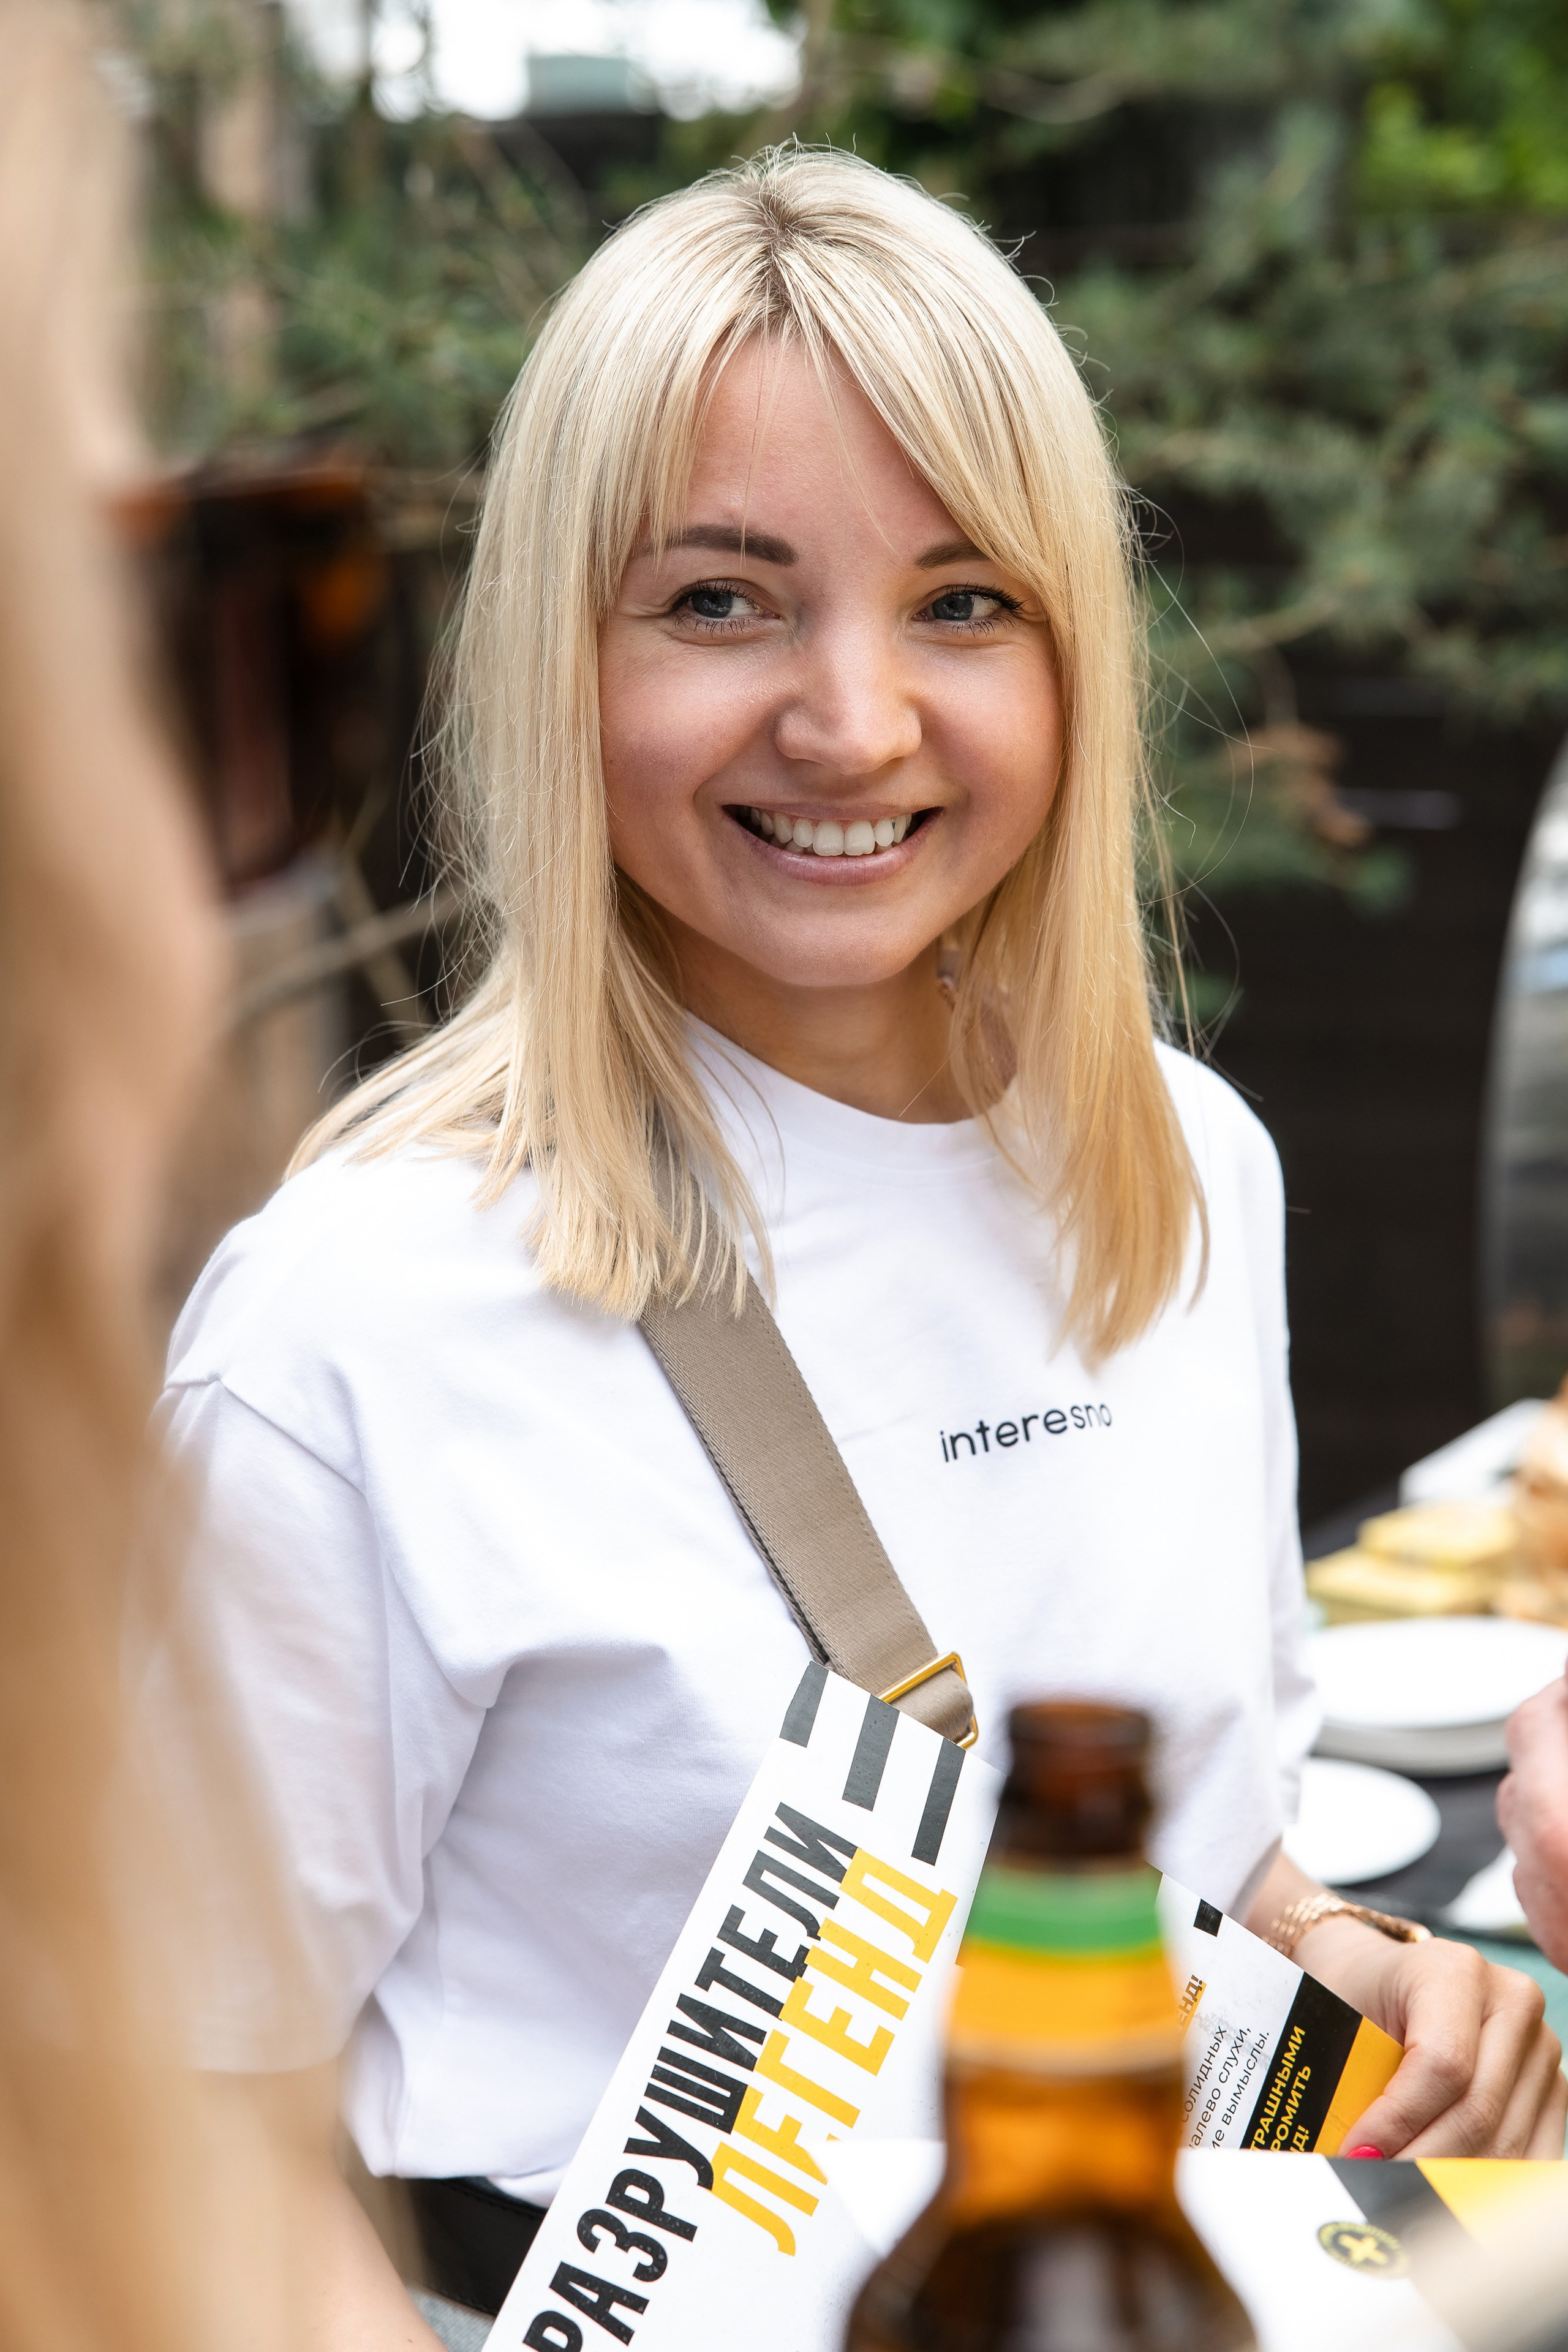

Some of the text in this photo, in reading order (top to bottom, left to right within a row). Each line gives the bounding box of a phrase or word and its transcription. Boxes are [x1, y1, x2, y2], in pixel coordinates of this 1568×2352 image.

[940, 1403, 1112, 1462] interesno
[1176, 1974, 1203, 2026] ЕНД!
[522, 1801, 859, 2352] РАЗРУШИТЕЛИ
[710, 1846, 958, 2257] ЛЕГЕНД
[1218, 2027, 1251, 2083] слухи,
[1221, 2032, 1270, 2125] вымыслы.
[1250, 2026, 1306, 2151] ТРАШНЫМИ
[1270, 2065, 1311, 2152] РОМИТЬ
